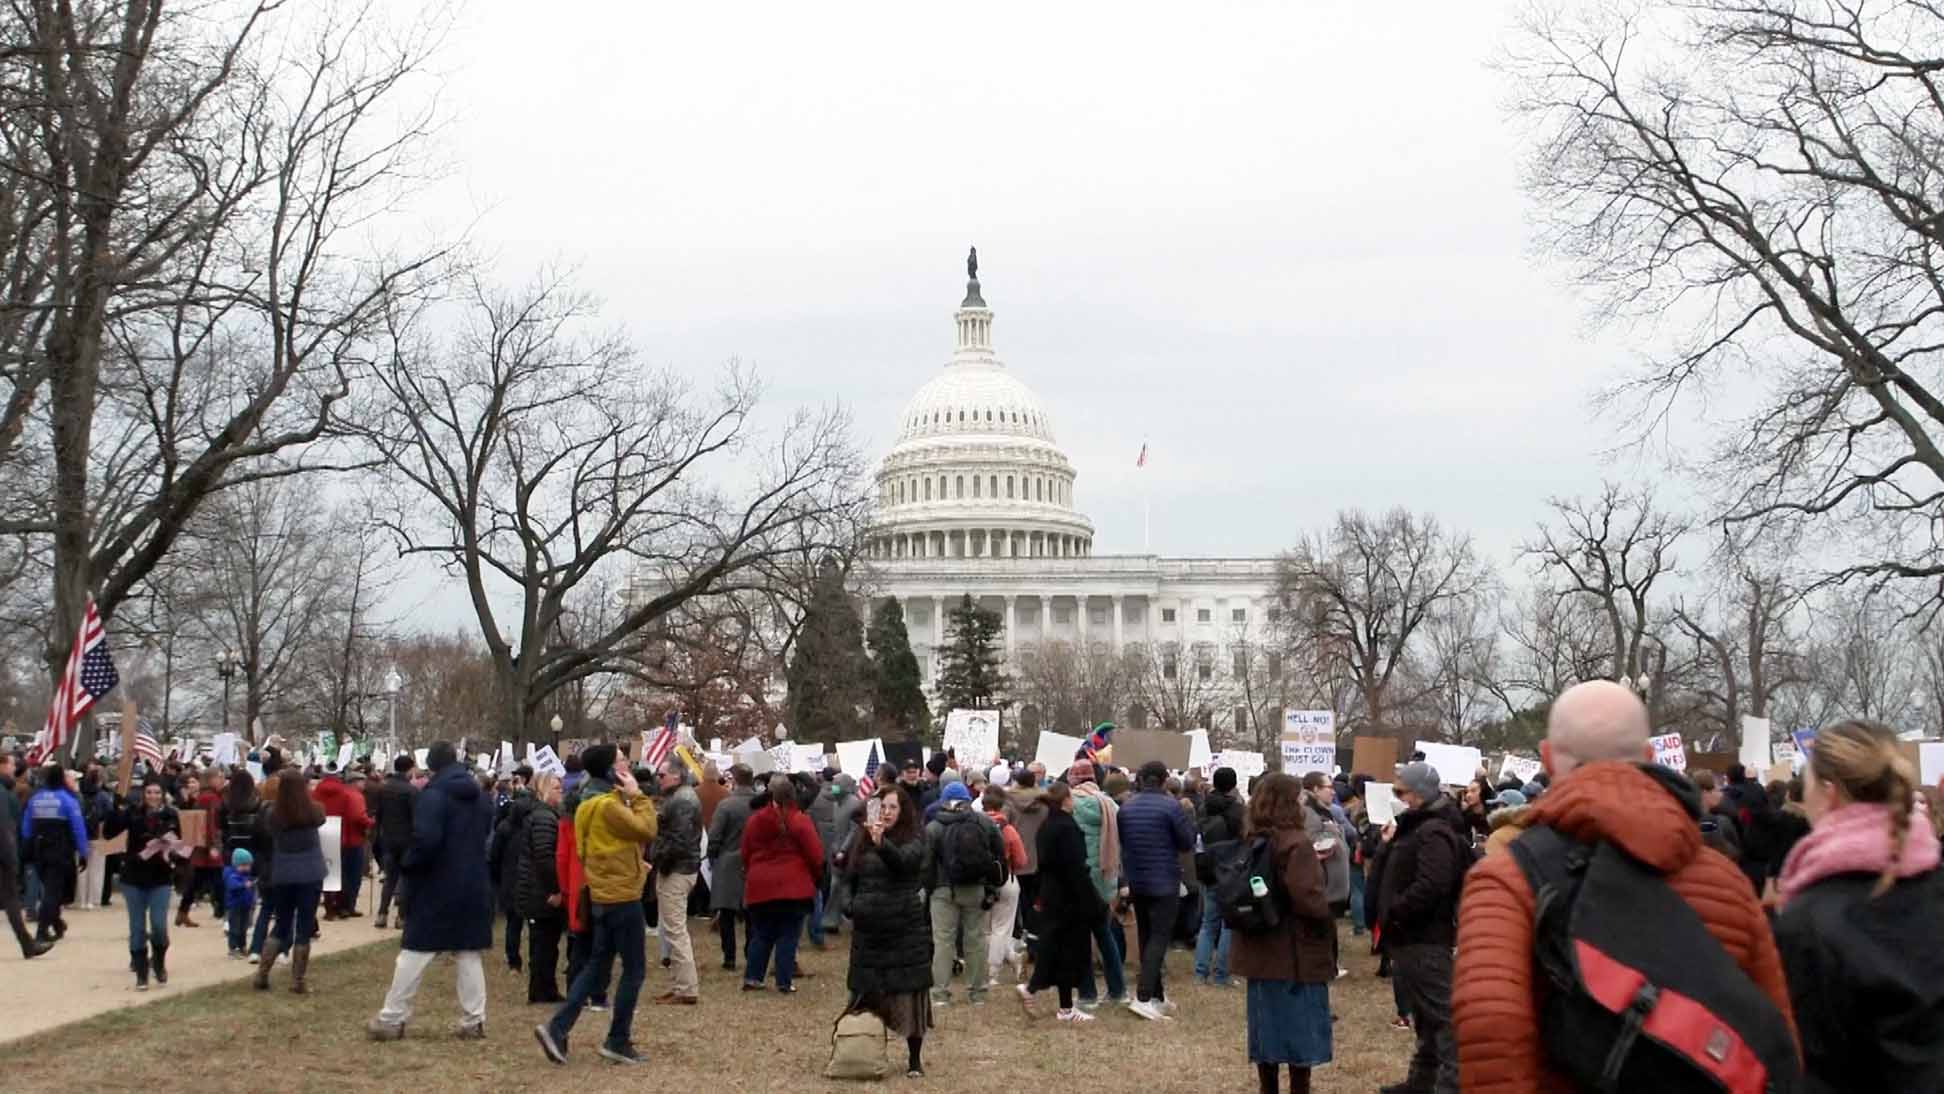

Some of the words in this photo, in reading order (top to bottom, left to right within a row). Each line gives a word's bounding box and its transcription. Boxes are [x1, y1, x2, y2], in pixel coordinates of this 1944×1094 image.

[1287, 714, 1309, 724] HELL
[1653, 736, 1681, 752] SAID
[1285, 754, 1309, 764] MUST
[1311, 755, 1329, 764] GO!
